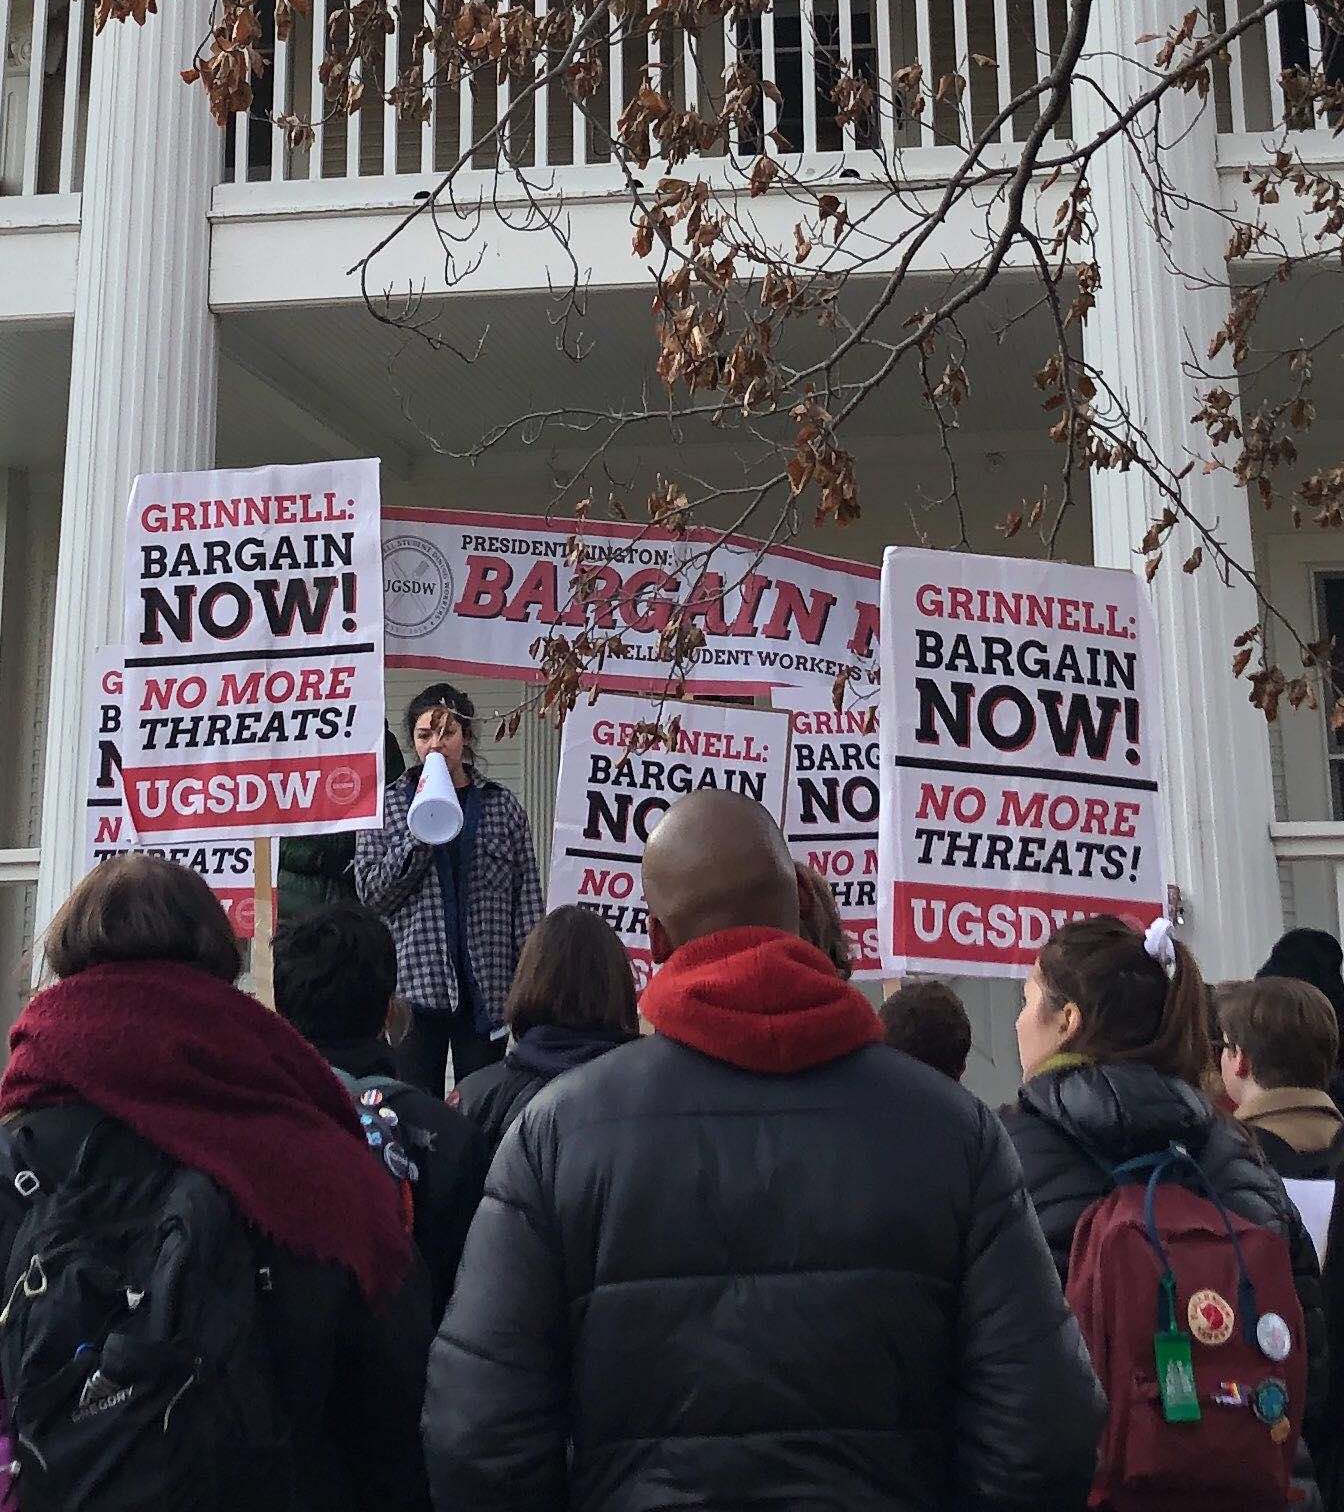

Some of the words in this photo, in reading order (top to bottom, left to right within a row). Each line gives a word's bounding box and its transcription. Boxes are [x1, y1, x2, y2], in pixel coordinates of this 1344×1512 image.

[140, 492, 355, 533] GRINNELL:
[140, 532, 354, 579] BARGAIN
[460, 534, 568, 559] PRESIDENT
[140, 571, 357, 645] NOW!
[453, 554, 838, 646] BARGAIN
[915, 584, 1137, 640] GRINNELL:
[915, 628, 1137, 691] BARGAIN
[139, 676, 207, 711] NO
[216, 666, 356, 706] MORE
[139, 705, 355, 751] THREATS!
[914, 677, 1141, 766] NOW!
[136, 770, 321, 819] UGSDW
[588, 754, 767, 802] BARGAIN
[915, 783, 986, 824] NO
[996, 790, 1141, 838] MORE
[914, 828, 1141, 883] THREATS!
[577, 868, 634, 899] NO
[911, 898, 1098, 950] UGSD
